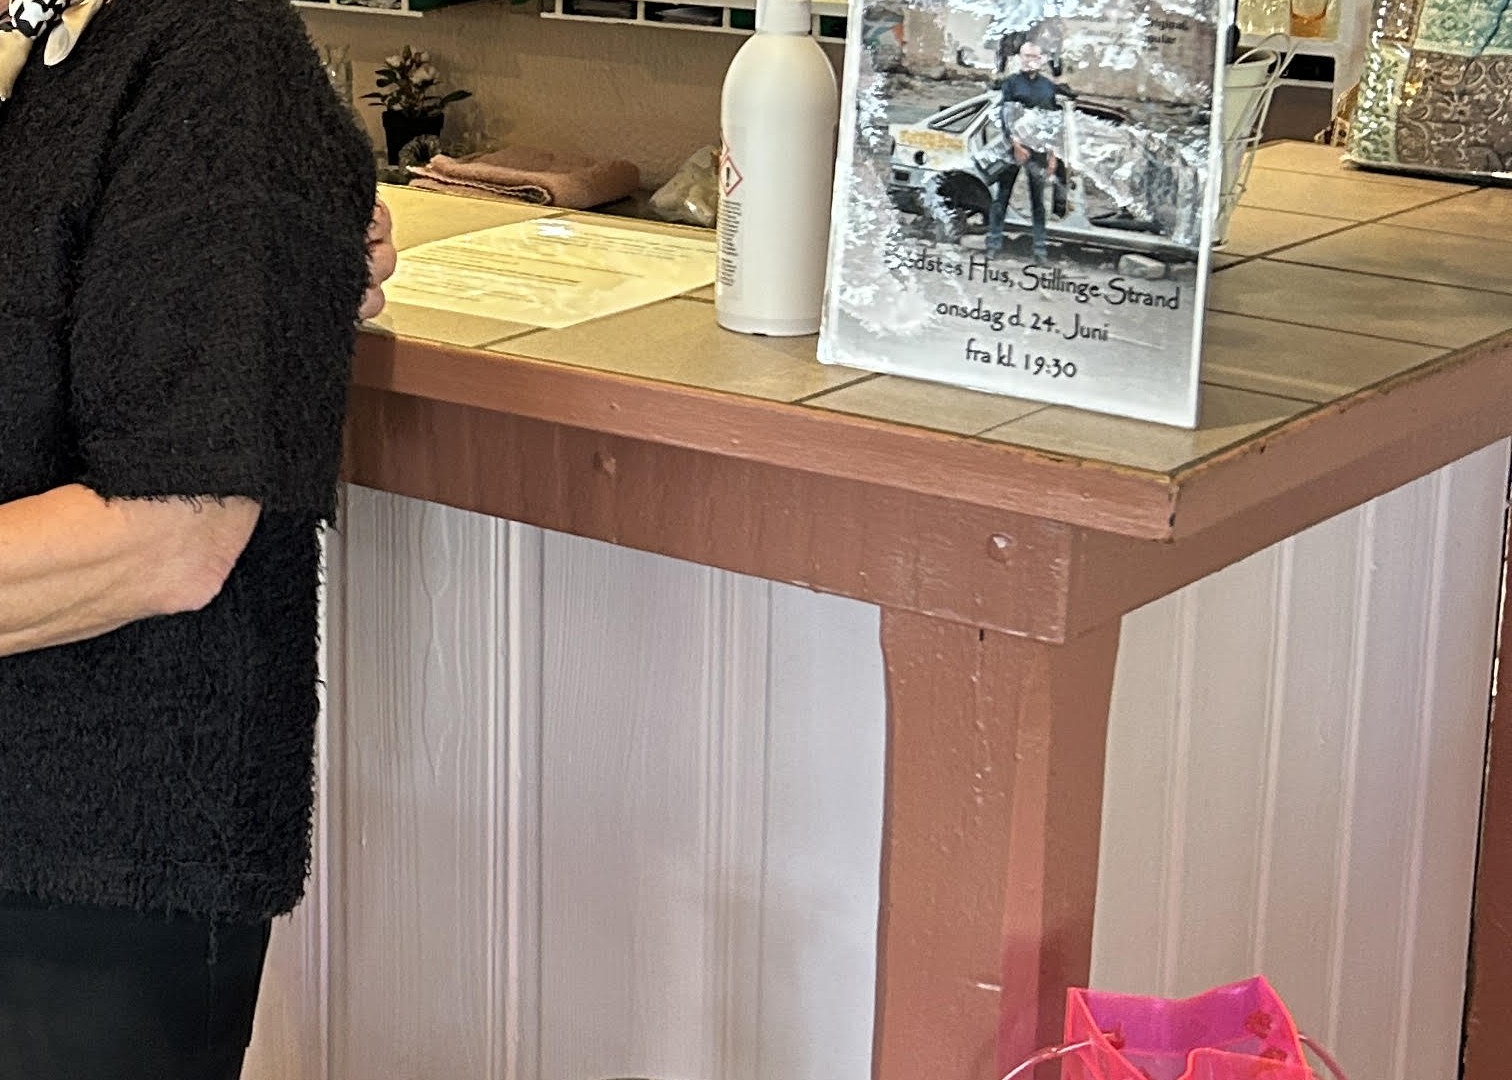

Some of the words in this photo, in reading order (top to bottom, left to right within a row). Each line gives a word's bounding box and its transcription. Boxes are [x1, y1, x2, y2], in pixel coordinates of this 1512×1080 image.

[967, 254, 1015, 288] Hus,
[1017, 264, 1102, 304] Stillinge
[1103, 277, 1181, 311] Strand
[935, 297, 1005, 332] onsdag
[1030, 313, 1061, 334] 24.
[1062, 313, 1110, 342] Juni
[965, 337, 991, 365] fra
[1024, 353, 1078, 378] 19:30
